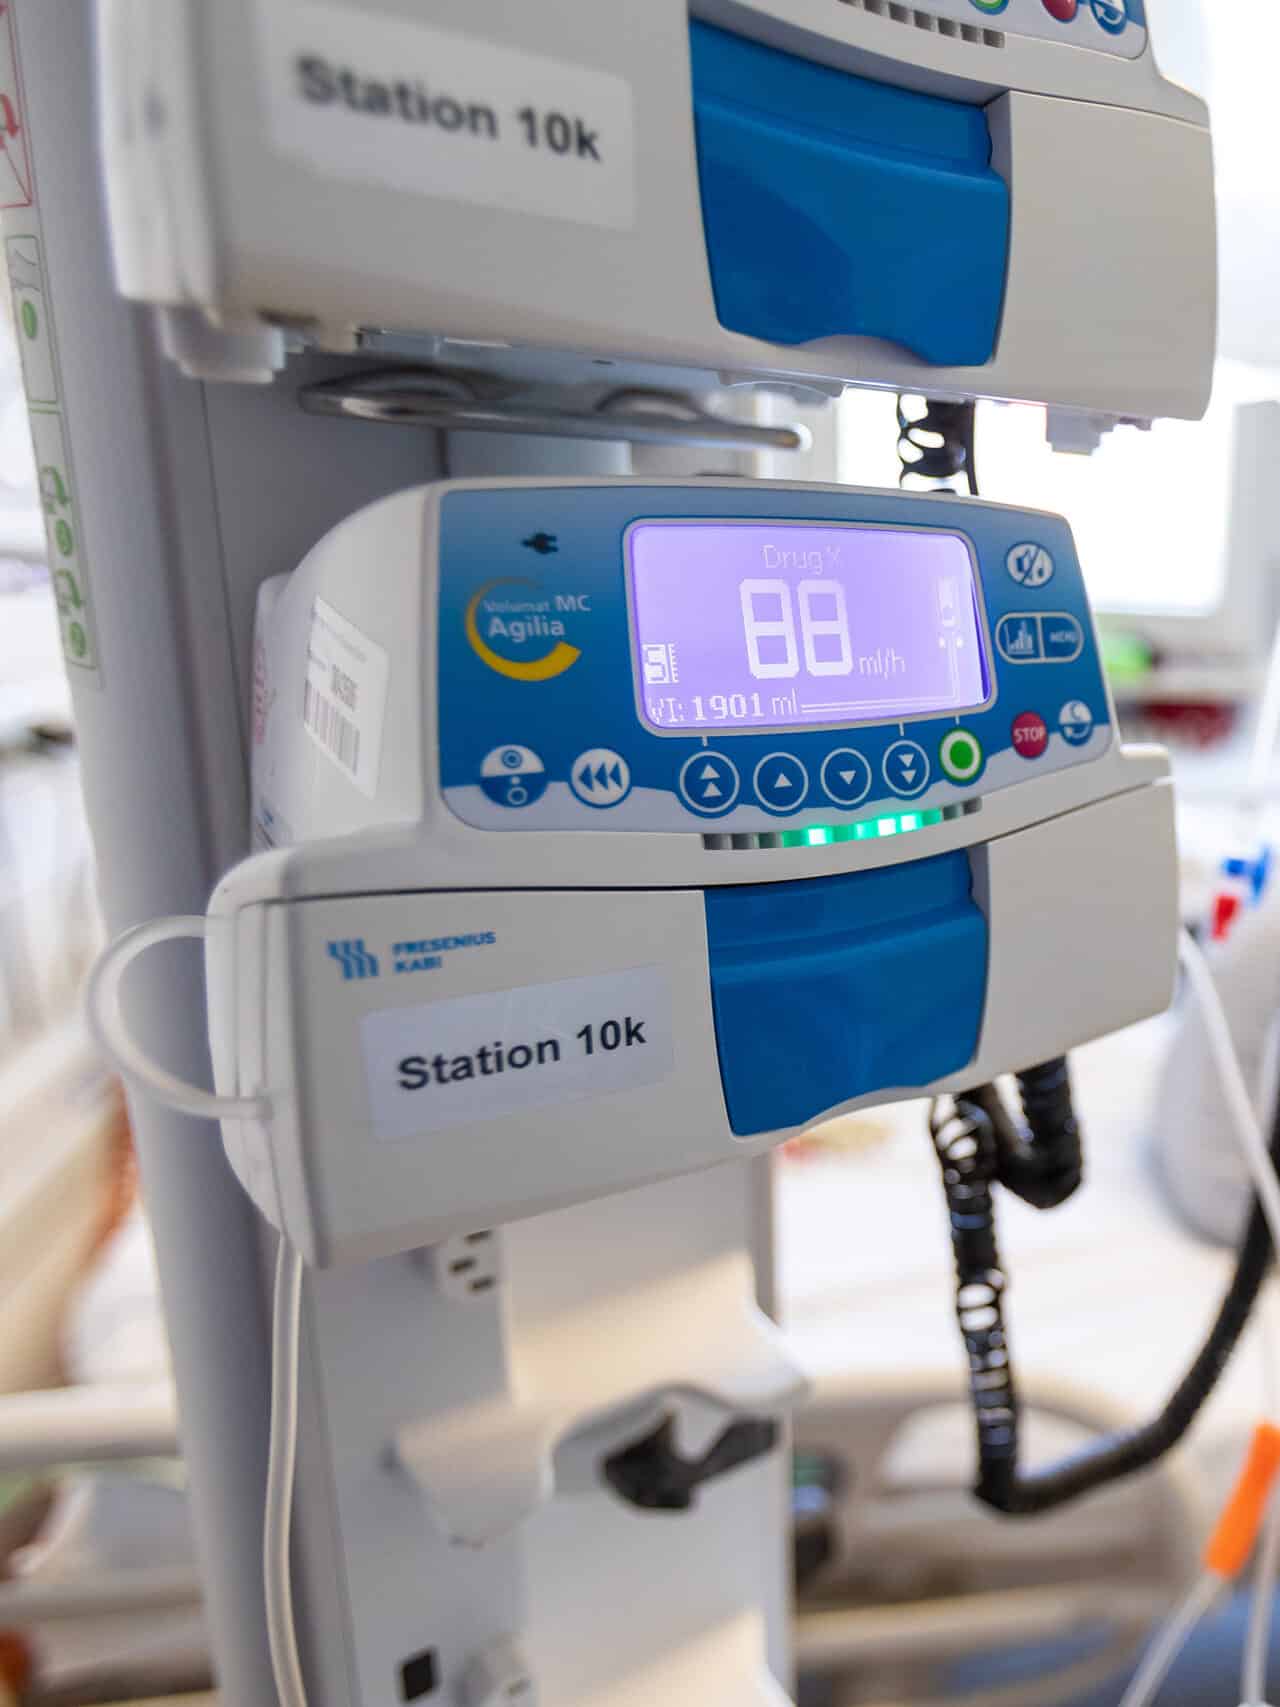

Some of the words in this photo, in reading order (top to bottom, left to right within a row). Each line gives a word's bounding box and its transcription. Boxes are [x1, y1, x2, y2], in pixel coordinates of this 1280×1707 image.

[294, 54, 499, 139] Station
[517, 106, 604, 163] 10k
[554, 594, 592, 612] MC
[488, 615, 565, 643] Agilia
[739, 578, 852, 679] 88
[692, 691, 765, 721] 1901
[771, 687, 798, 716] ml
[1013, 725, 1044, 744] STOP
[393, 931, 497, 955] FRESENIUS
[393, 956, 442, 974] KABI
[397, 1038, 562, 1091] Station
[576, 1016, 648, 1056] 10k
